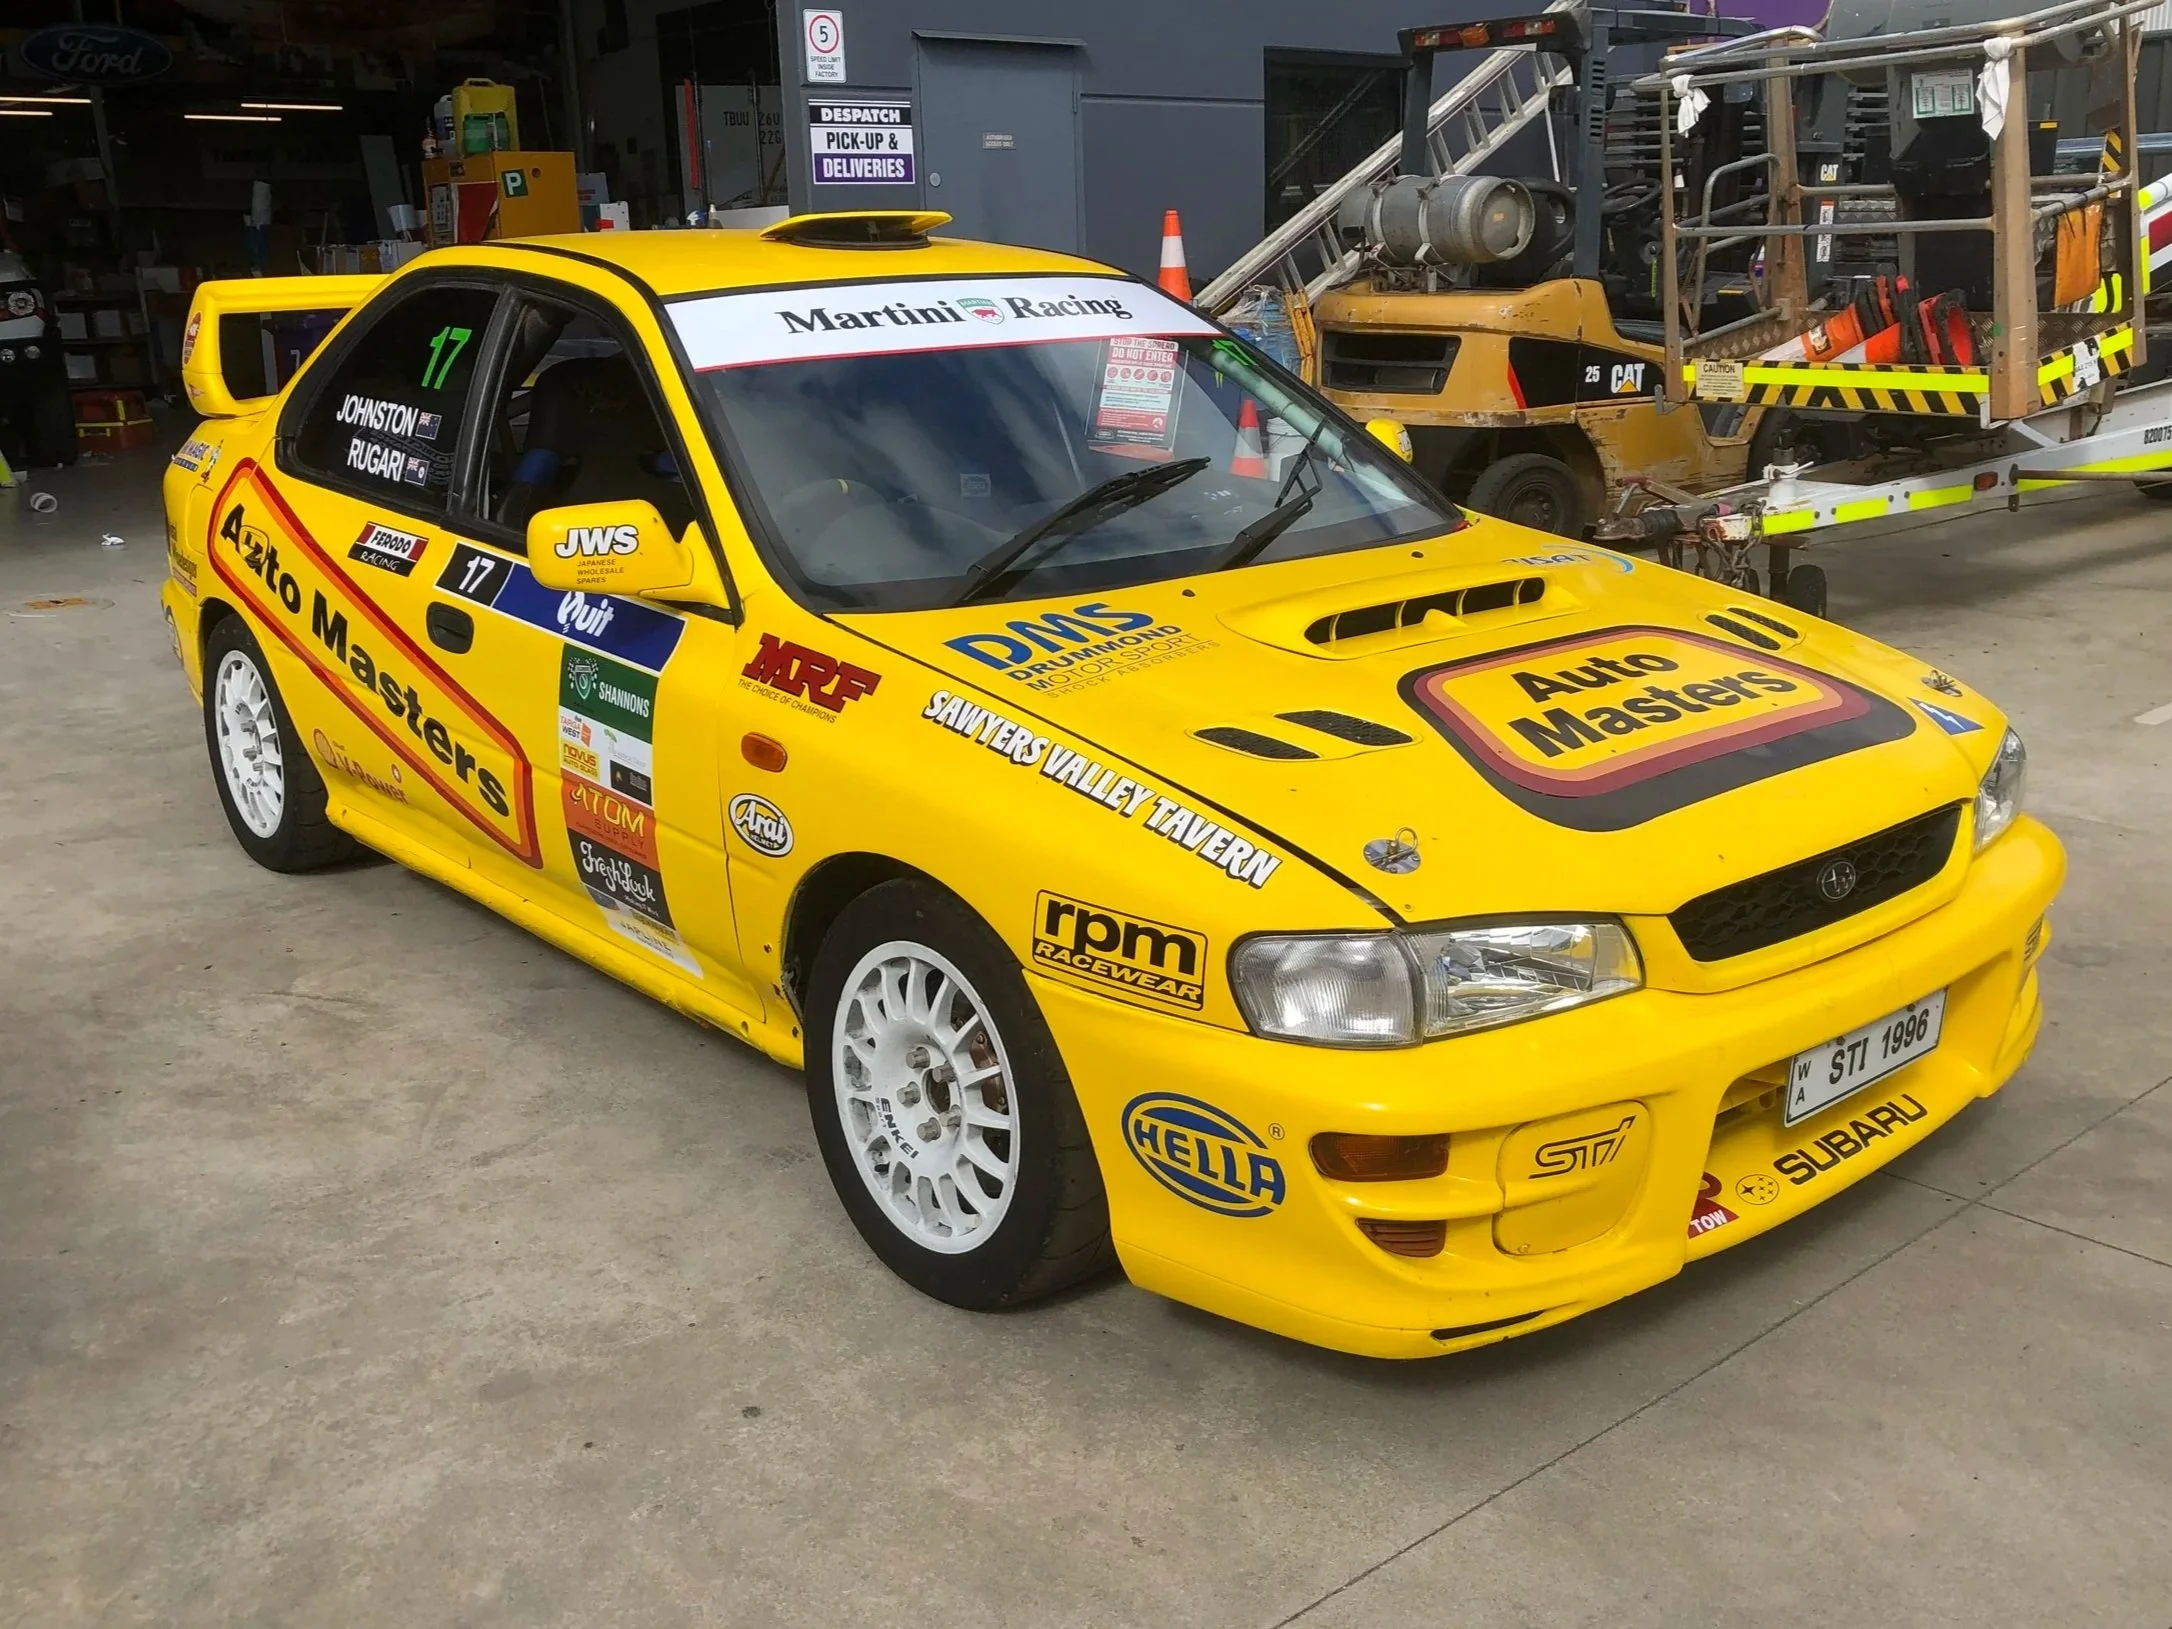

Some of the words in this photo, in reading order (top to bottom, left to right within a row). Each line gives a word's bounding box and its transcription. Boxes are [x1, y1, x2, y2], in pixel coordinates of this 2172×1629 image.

[819, 25, 829, 43] 5
[51, 32, 144, 76] Ford
[810, 55, 827, 63] SPEED
[817, 63, 835, 71] INSIDE
[815, 70, 838, 78] FACTORY
[820, 107, 901, 123] DESPATCH
[826, 131, 884, 150] PICK-UP
[888, 133, 899, 150] &
[505, 172, 521, 195] P
[822, 157, 905, 179] DELIVERIES
[1821, 164, 1839, 181] CAT
[775, 300, 967, 335] Martini
[1000, 294, 1133, 320] Racing
[421, 326, 473, 390] 17
[1112, 347, 1125, 358] DO
[1126, 348, 1144, 361] NOT
[1145, 350, 1174, 363] ENTER
[1703, 363, 1736, 373] CAUTION
[1585, 365, 1601, 383] 25
[1611, 363, 1645, 393] CAT
[336, 394, 419, 437] JOHNSTON
[347, 438, 406, 482] RUGARI
[370, 529, 412, 554] FERODO
[554, 524, 639, 558] JWS
[359, 550, 400, 572] RACING
[458, 555, 496, 594] 17
[576, 576, 606, 585] SPARES
[577, 558, 616, 567] JAPANESE
[577, 567, 624, 576] WHOLESALE
[556, 590, 615, 637] Quit
[942, 602, 1154, 671] DMS
[1005, 624, 1182, 682] DRUMMOND
[741, 632, 883, 714] MRF
[1027, 656, 1121, 692] MOTOR
[1120, 632, 1202, 662] SPORT
[1047, 675, 1112, 699] SHOCK
[1117, 640, 1221, 677] ABSORBERS
[1511, 652, 1680, 703] Auto
[311, 589, 510, 818] Masters
[598, 681, 650, 718] SHANNONS
[737, 678, 751, 690] THE
[751, 683, 778, 701] CHOICE
[779, 692, 791, 705] OF
[790, 697, 838, 724] CHAMPIONS
[1507, 668, 1798, 758] Masters
[561, 725, 581, 740] WEST
[921, 689, 1051, 766] SAWYERS
[1039, 744, 1157, 818] VALLEY
[1143, 796, 1283, 890] TAVERN
[571, 782, 645, 837] ATOM
[735, 800, 786, 844] Arai
[594, 818, 645, 849] SUPPLY
[1045, 898, 1198, 976] rpm
[1034, 941, 1203, 1001] RACEWEAR
[1829, 1042, 1868, 1086] STI
[1881, 1007, 1928, 1061] 1996
[1797, 1059, 1812, 1081] W
[1795, 1086, 1806, 1106] A
[880, 1098, 920, 1159] ENKEI
[1773, 1092, 1929, 1186] SUBARU
[1134, 1117, 1286, 1207] HELLA
[1689, 1208, 1728, 1234] TOW
